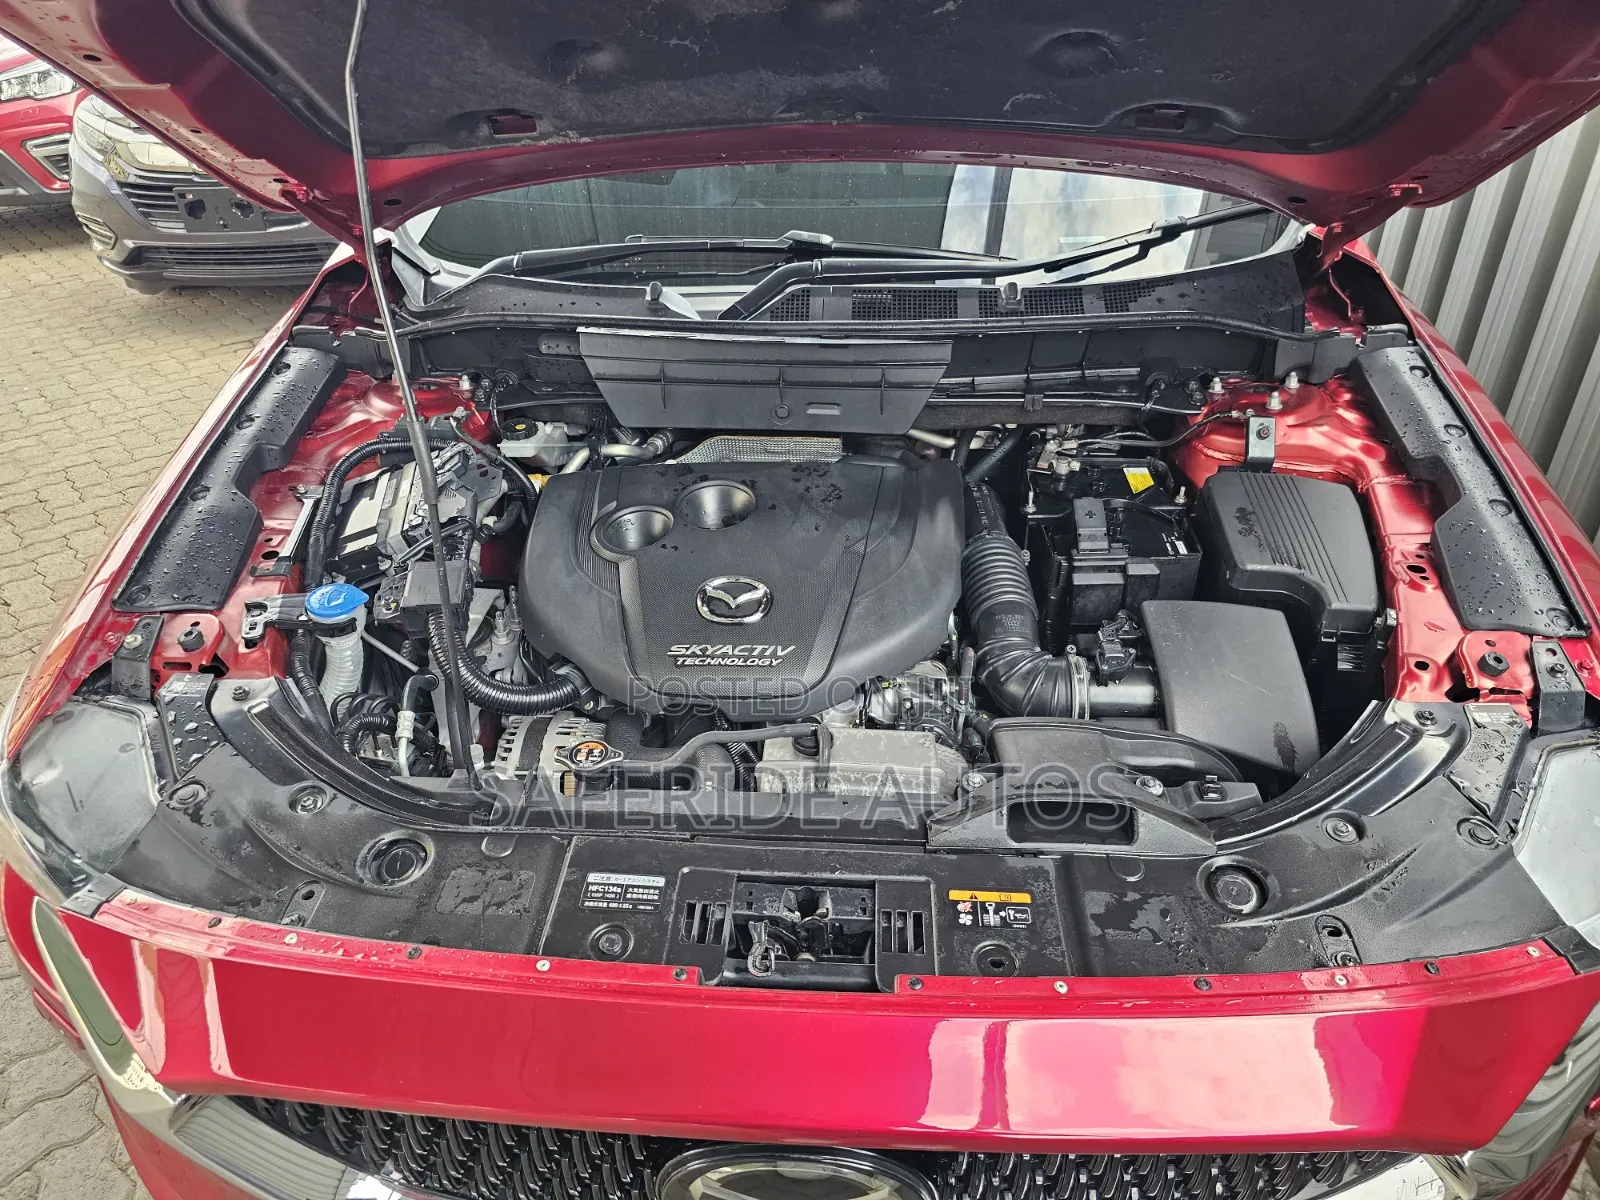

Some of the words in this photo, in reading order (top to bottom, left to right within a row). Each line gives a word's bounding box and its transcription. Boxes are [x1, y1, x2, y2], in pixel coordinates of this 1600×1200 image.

[667, 644, 796, 656] SKYACTIV
[676, 657, 783, 667] TECHNOLOGY
[588, 885, 621, 893] HFC134a
